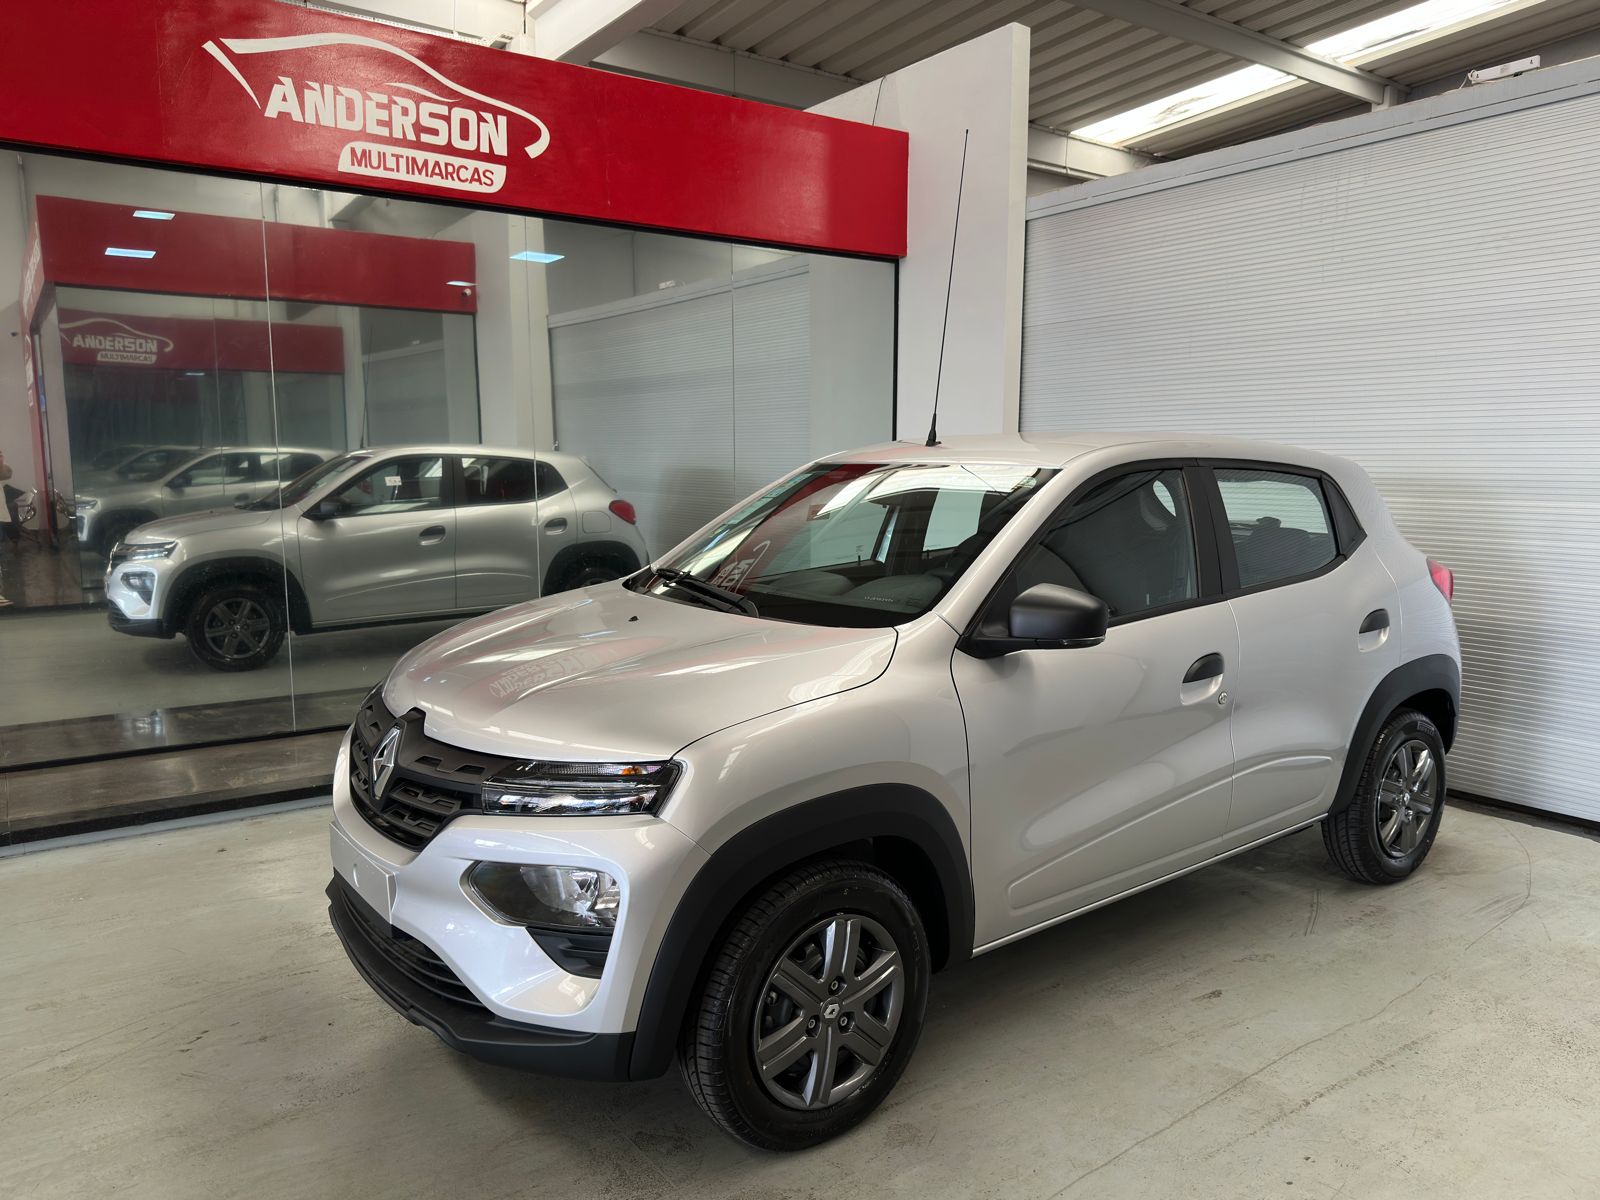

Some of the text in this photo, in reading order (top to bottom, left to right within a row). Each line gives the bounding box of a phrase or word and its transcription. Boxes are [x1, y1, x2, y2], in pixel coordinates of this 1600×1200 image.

[264, 75, 508, 157] ANDERSON
[350, 146, 495, 187] MULTIMARCAS
[72, 334, 158, 353] ANDERSON
